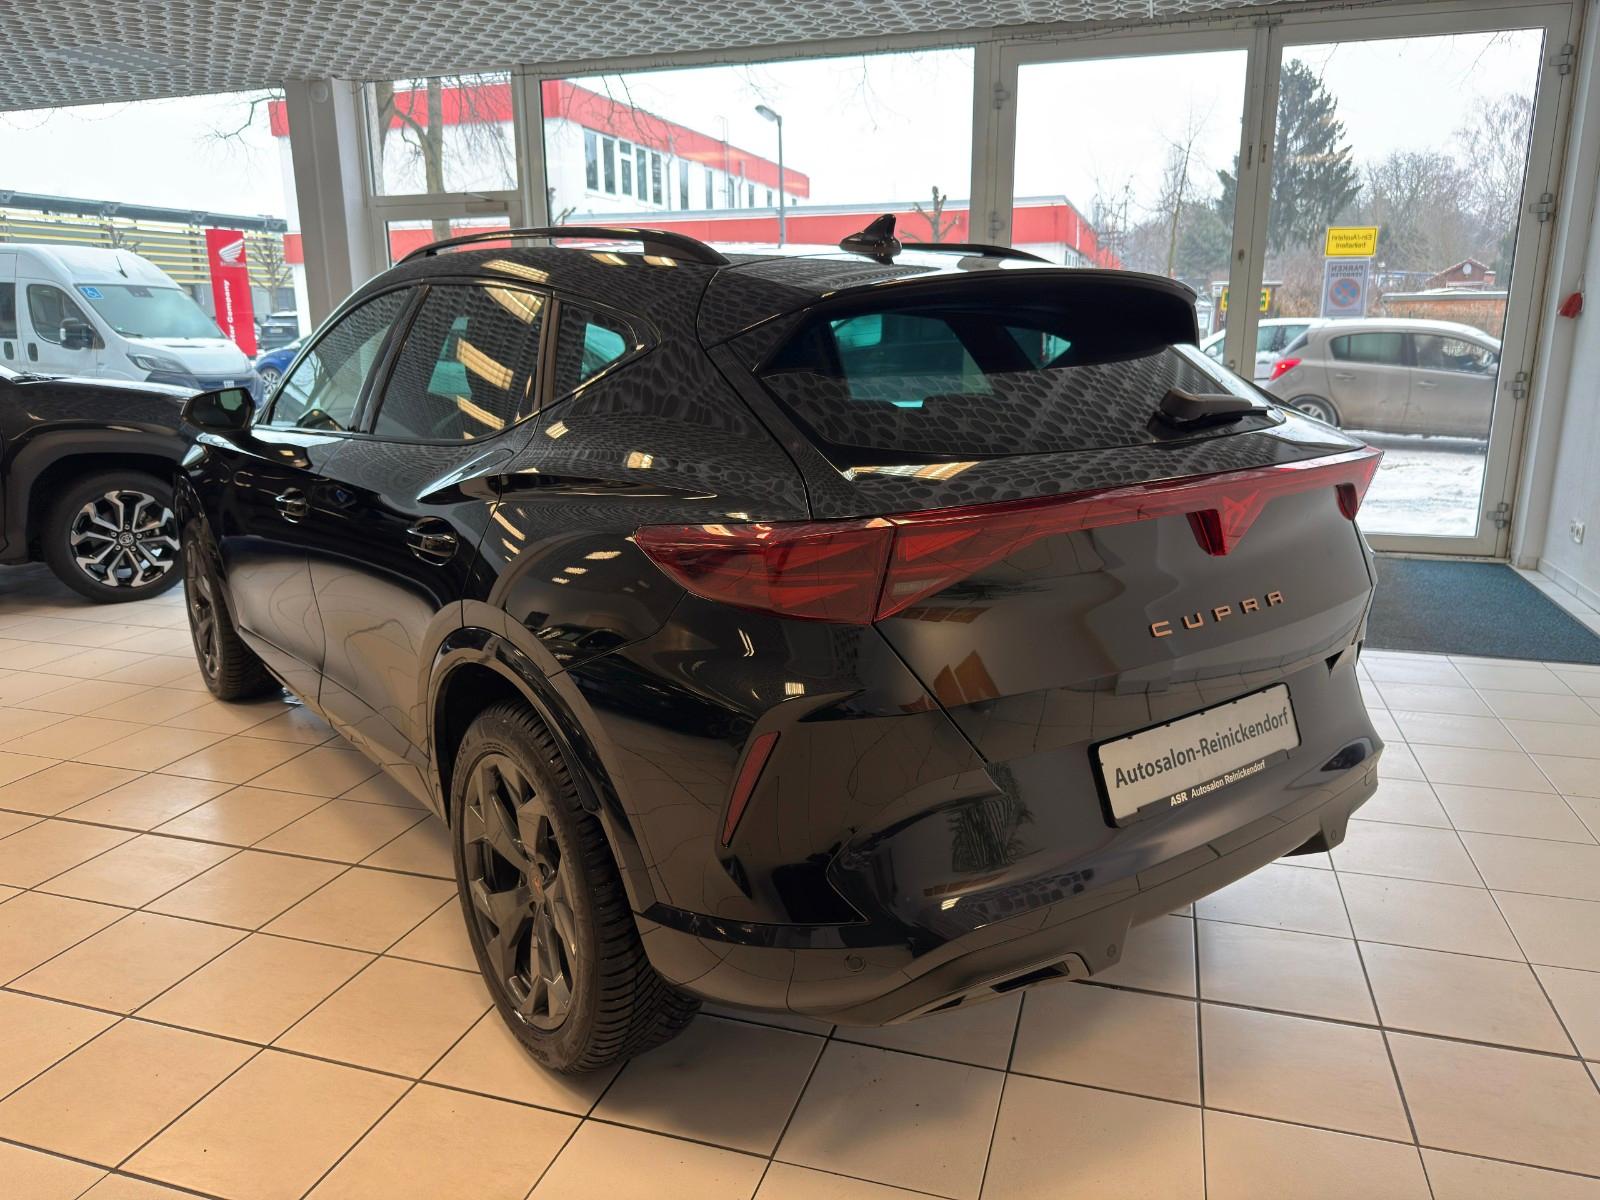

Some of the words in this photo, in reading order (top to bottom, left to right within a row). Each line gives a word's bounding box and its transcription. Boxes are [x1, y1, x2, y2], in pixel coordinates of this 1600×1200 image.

[223, 280, 234, 323] Company
[1150, 589, 1285, 638] CUPRA
[1115, 706, 1289, 788] Autosalon-Reinickendorf
[1169, 791, 1188, 807] ASR
[1190, 778, 1225, 799] Autosalon
[1224, 761, 1266, 785] Reinickendorf
